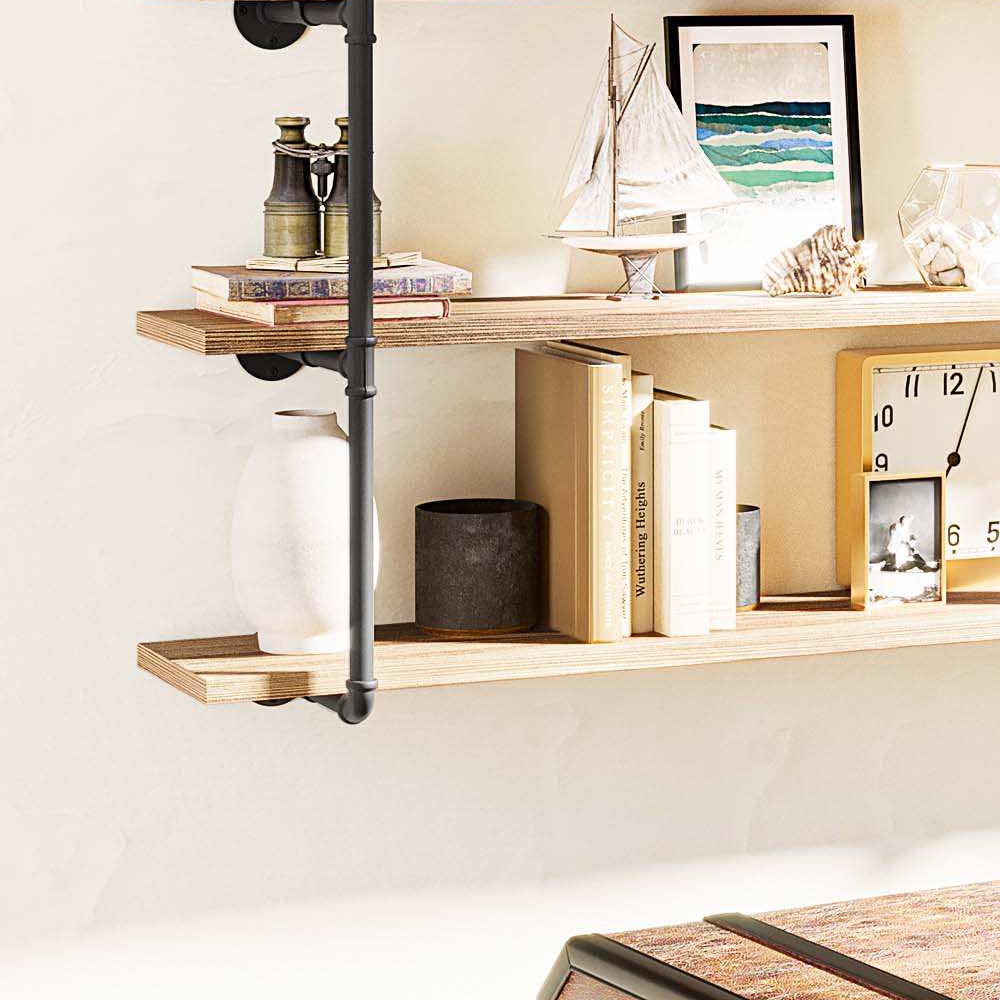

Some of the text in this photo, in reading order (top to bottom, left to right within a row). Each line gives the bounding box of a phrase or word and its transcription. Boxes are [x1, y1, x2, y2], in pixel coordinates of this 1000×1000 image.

[904, 373, 920, 398] 11
[943, 371, 965, 396] 12
[988, 370, 998, 393] 1
[874, 403, 895, 432] 10
[602, 384, 615, 522] SIMPLICITY
[874, 452, 889, 473] 9
[635, 481, 648, 529] Heights
[947, 523, 961, 547] 6
[986, 520, 1000, 544] 5
[635, 532, 648, 598] Wuthering
